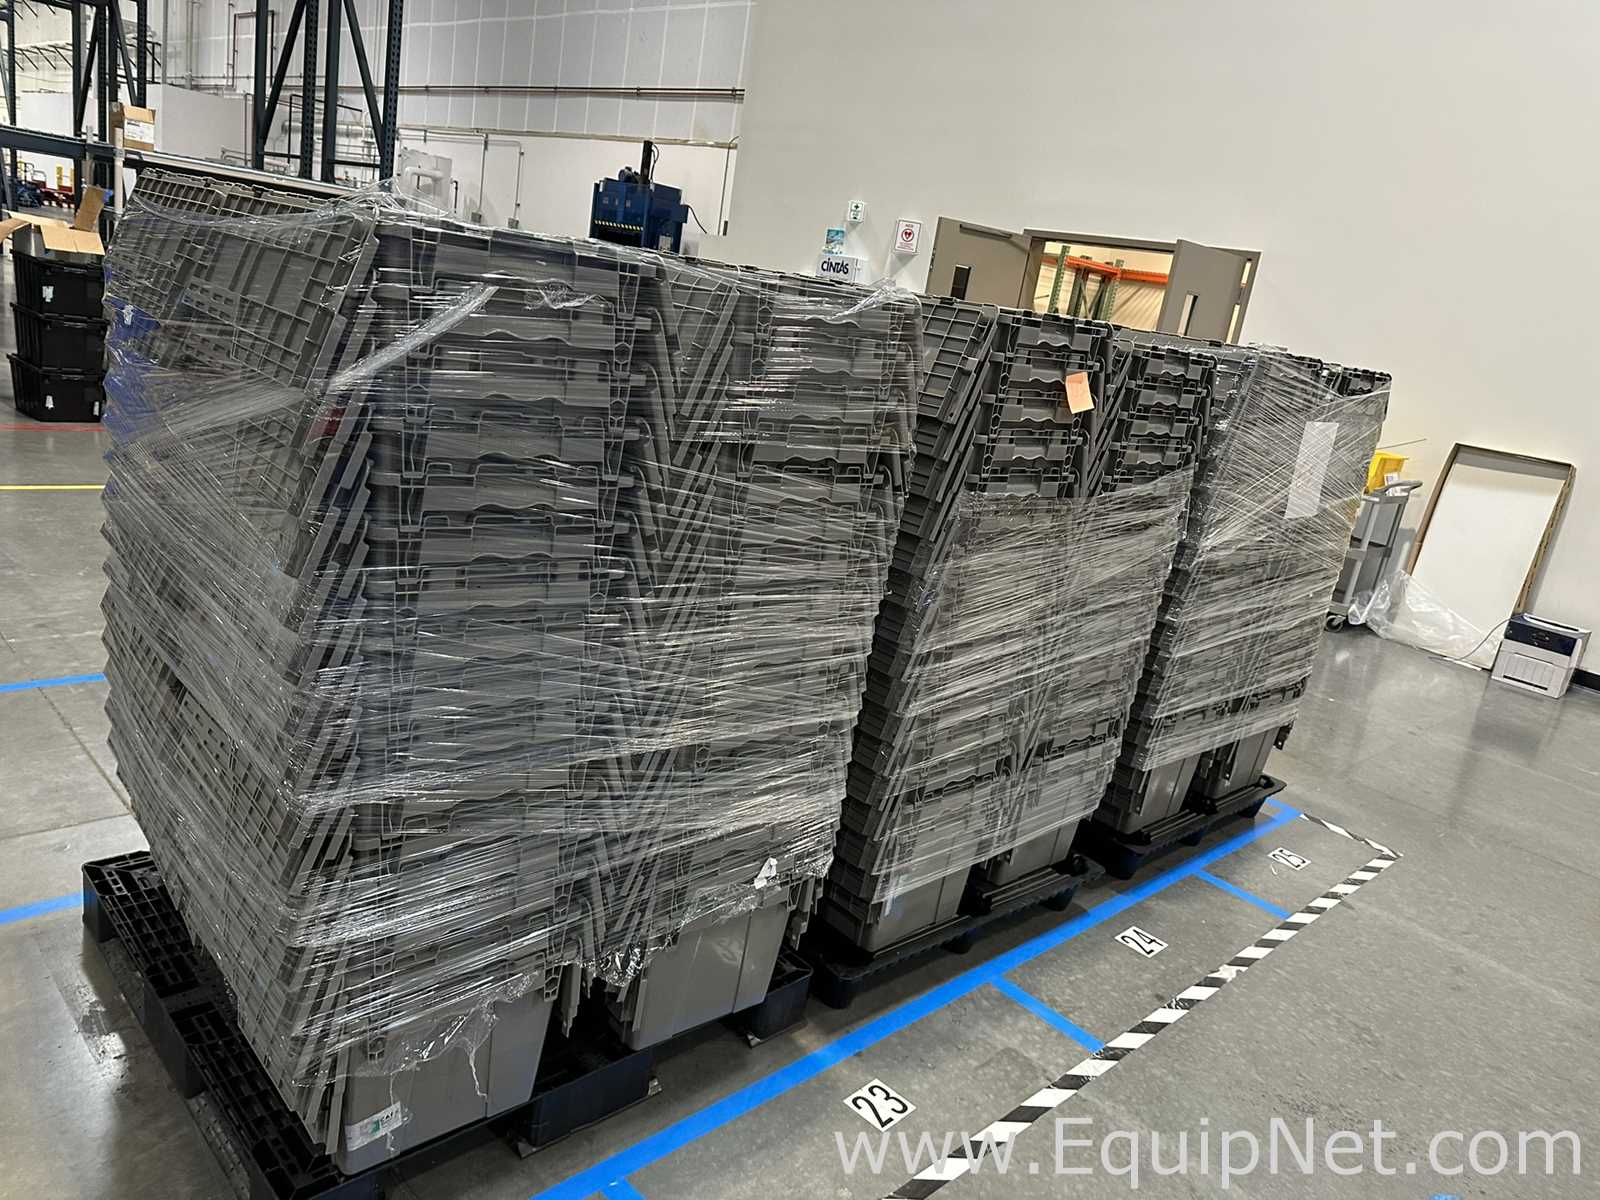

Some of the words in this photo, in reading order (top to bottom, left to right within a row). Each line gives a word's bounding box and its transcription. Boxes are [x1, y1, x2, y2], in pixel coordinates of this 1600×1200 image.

[1271, 849, 1306, 868] 25
[1120, 929, 1164, 955] 24
[851, 1084, 908, 1128] 23
